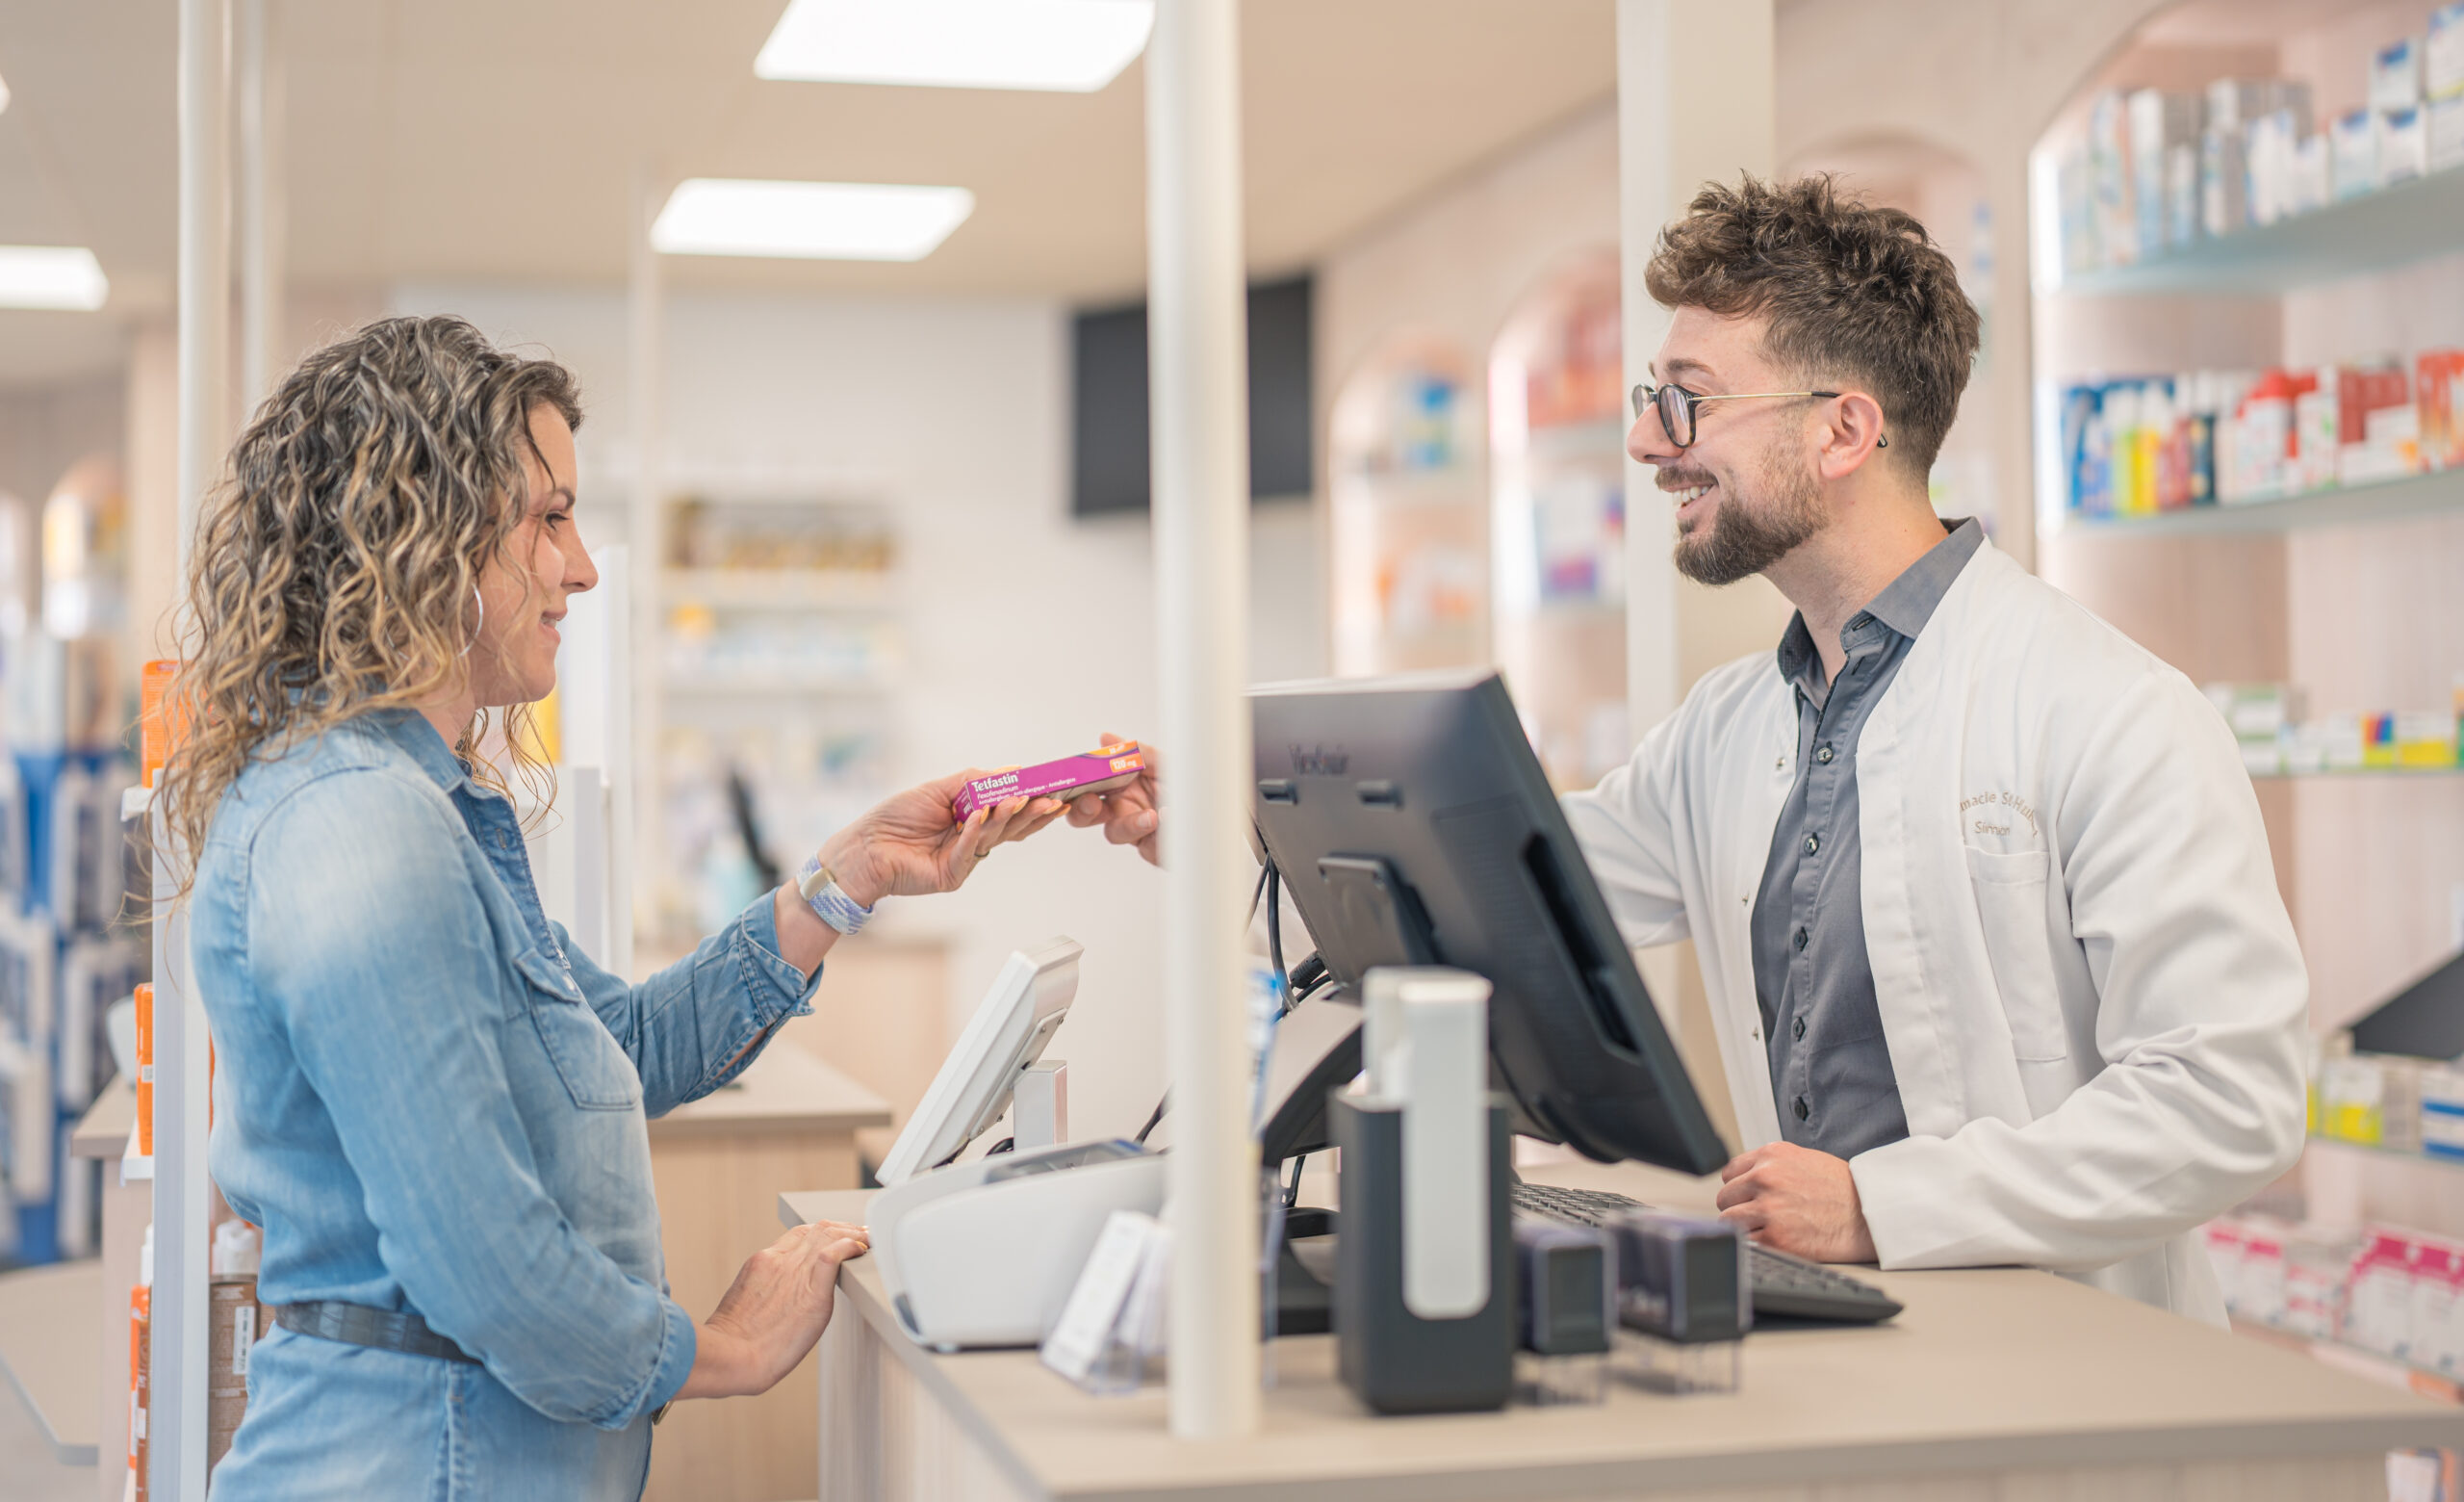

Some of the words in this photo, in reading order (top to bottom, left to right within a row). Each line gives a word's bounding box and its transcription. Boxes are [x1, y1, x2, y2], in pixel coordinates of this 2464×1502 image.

[1112, 760, 1126, 770] 120
[971, 773, 1019, 791] Telfastin
[1960, 791, 1997, 811] macie
